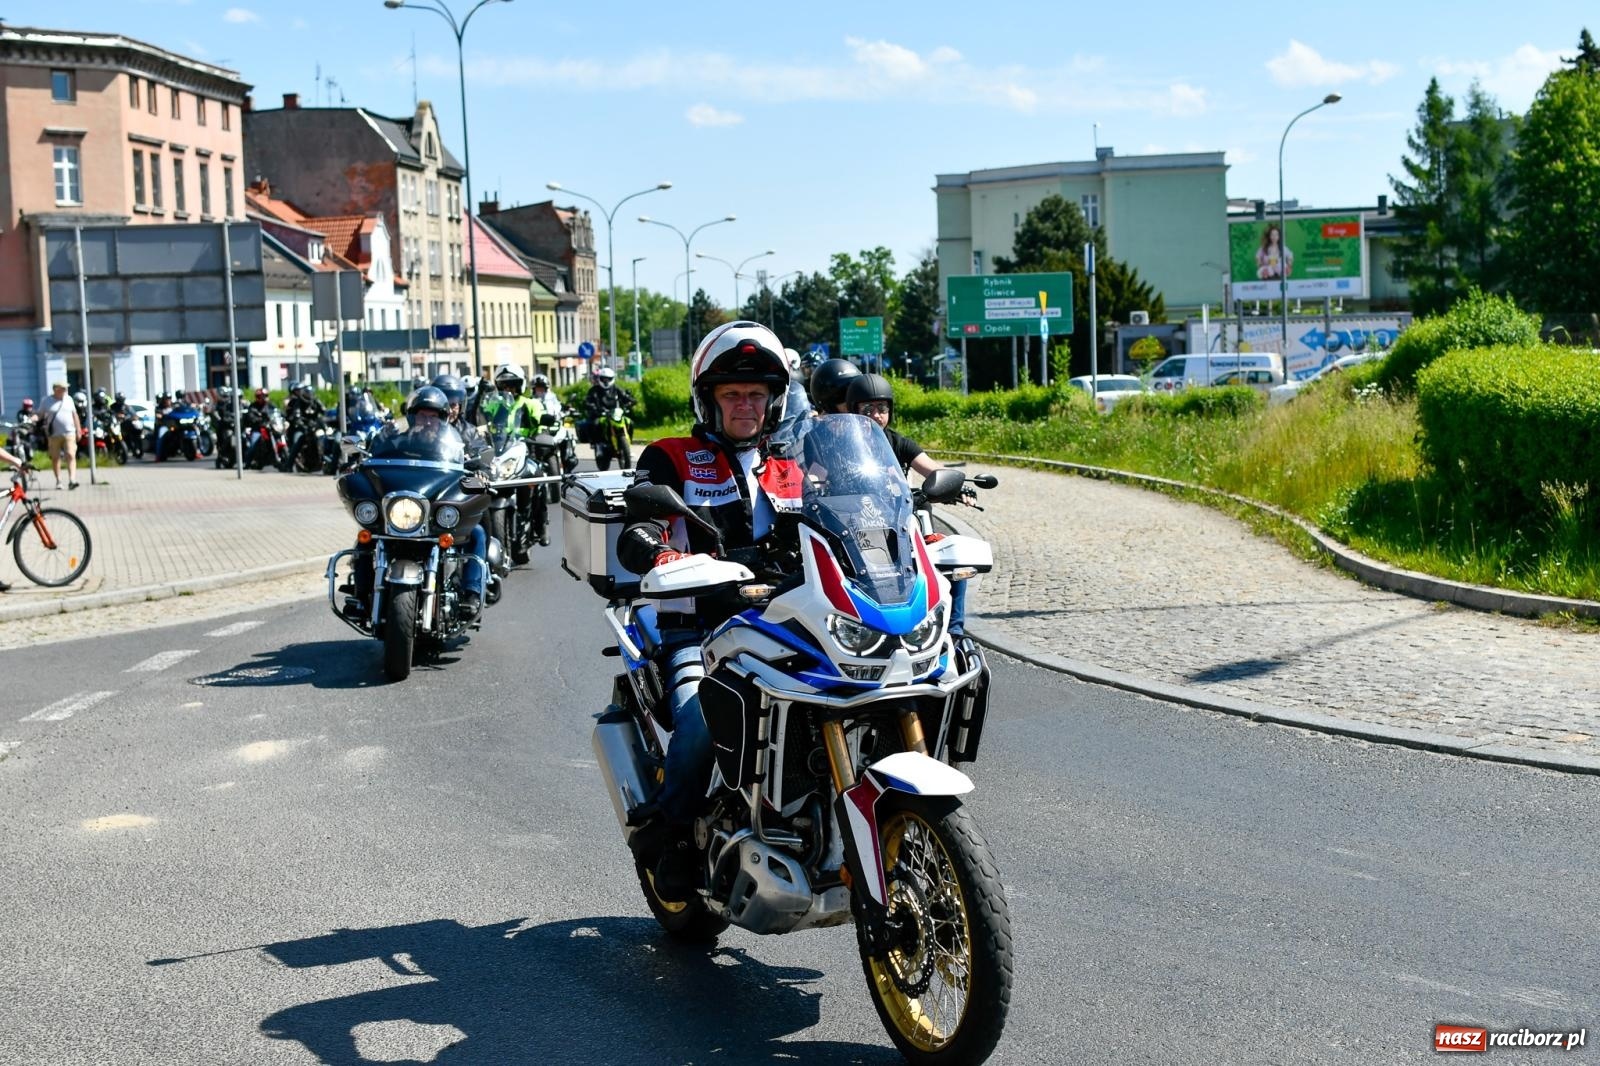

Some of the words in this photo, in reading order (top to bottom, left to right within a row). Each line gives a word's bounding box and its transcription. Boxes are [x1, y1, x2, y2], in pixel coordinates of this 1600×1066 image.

[984, 278, 1012, 287] Rybnik
[984, 288, 1015, 297] Gliwice
[984, 324, 1011, 334] Opole
[860, 517, 888, 528] DAKAR
